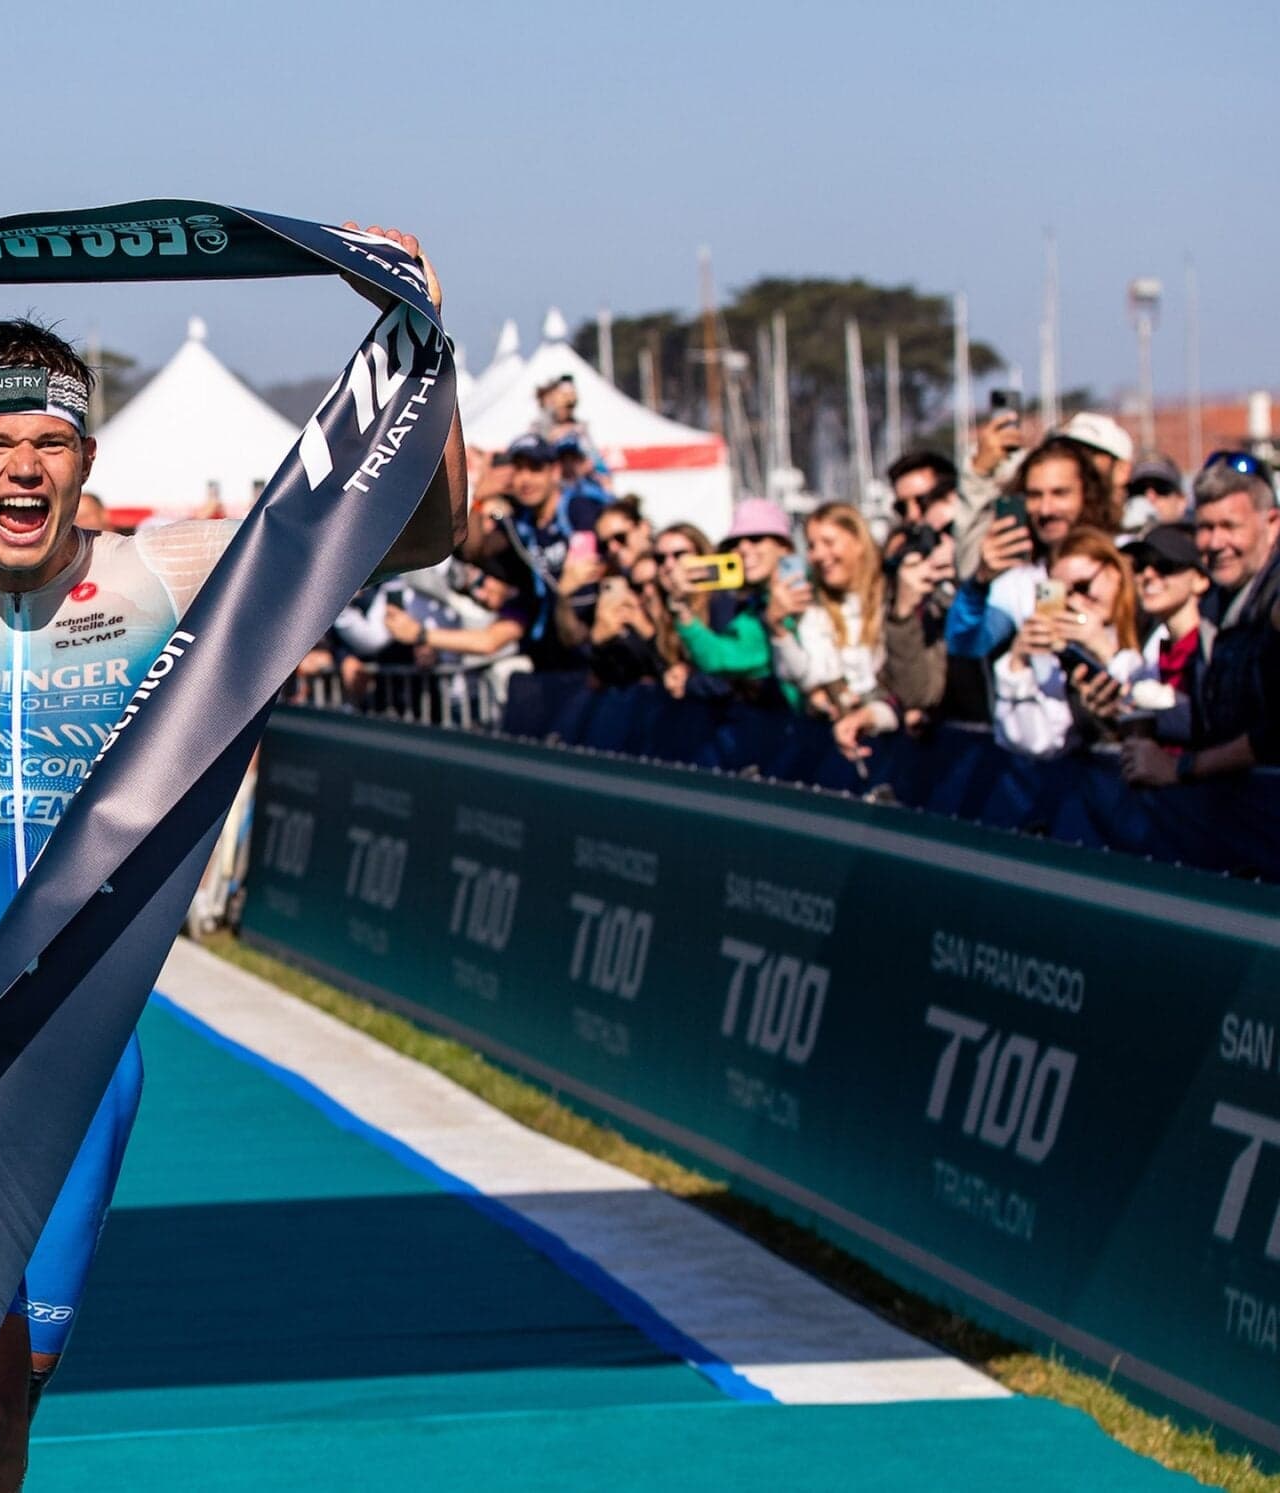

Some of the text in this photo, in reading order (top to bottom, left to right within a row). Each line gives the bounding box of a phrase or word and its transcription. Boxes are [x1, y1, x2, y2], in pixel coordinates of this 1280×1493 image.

[342, 240, 433, 302] TRIA
[55, 612, 105, 628] schnelle
[55, 628, 127, 649] OLYMP
[69, 616, 124, 634] Stelle.de
[569, 892, 655, 1001] T100
[931, 929, 1086, 1014] SAN FRANCISCO
[719, 935, 832, 1066] T100
[1220, 1011, 1275, 1072] SAN
[925, 1004, 1079, 1165] T100
[1223, 1285, 1280, 1352] TRIA
